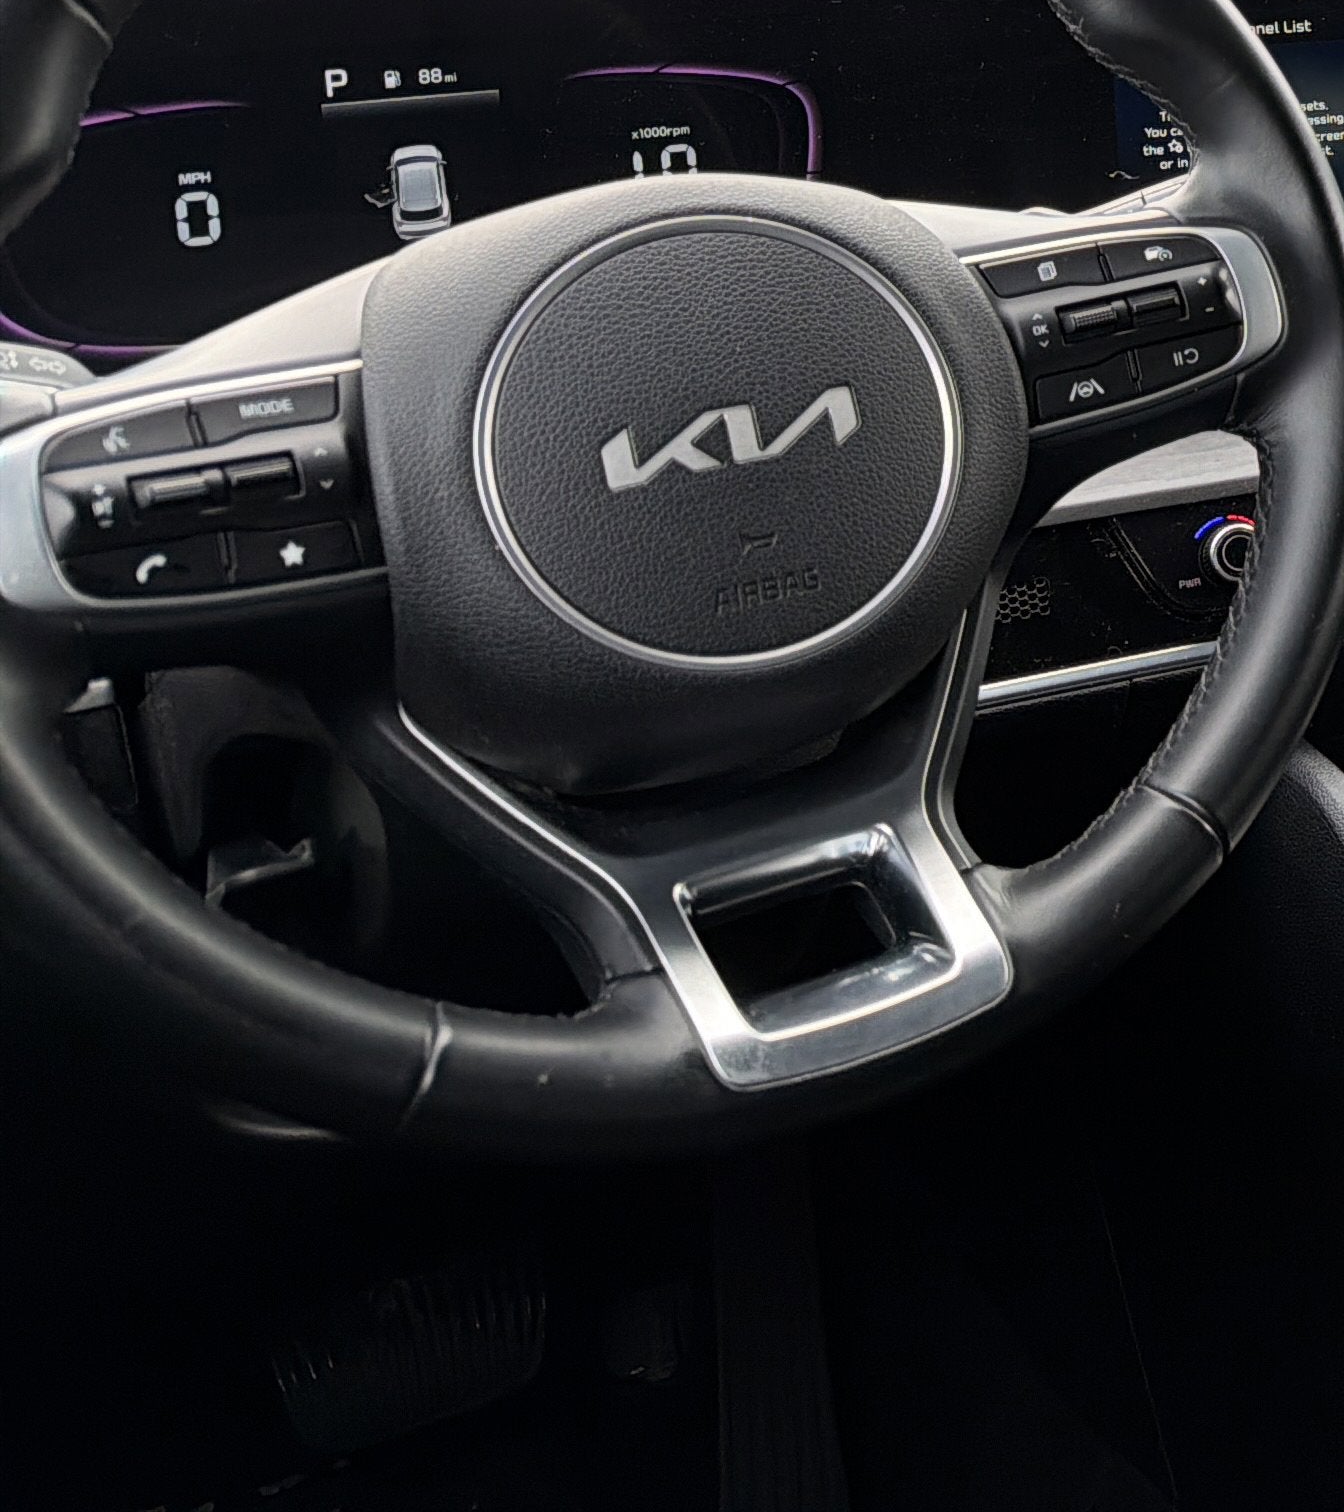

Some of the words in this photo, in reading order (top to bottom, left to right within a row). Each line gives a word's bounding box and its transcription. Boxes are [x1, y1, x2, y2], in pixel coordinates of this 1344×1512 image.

[1283, 19, 1312, 34] List
[324, 69, 348, 98] P
[1144, 127, 1168, 138] You
[1142, 144, 1165, 156] the
[1160, 160, 1174, 170] or
[178, 170, 212, 187] MPH
[174, 191, 222, 247] 0
[1032, 322, 1050, 336] OK
[238, 397, 296, 419] MODE
[1178, 576, 1202, 590] PWR
[714, 568, 823, 617] AIRBAG
